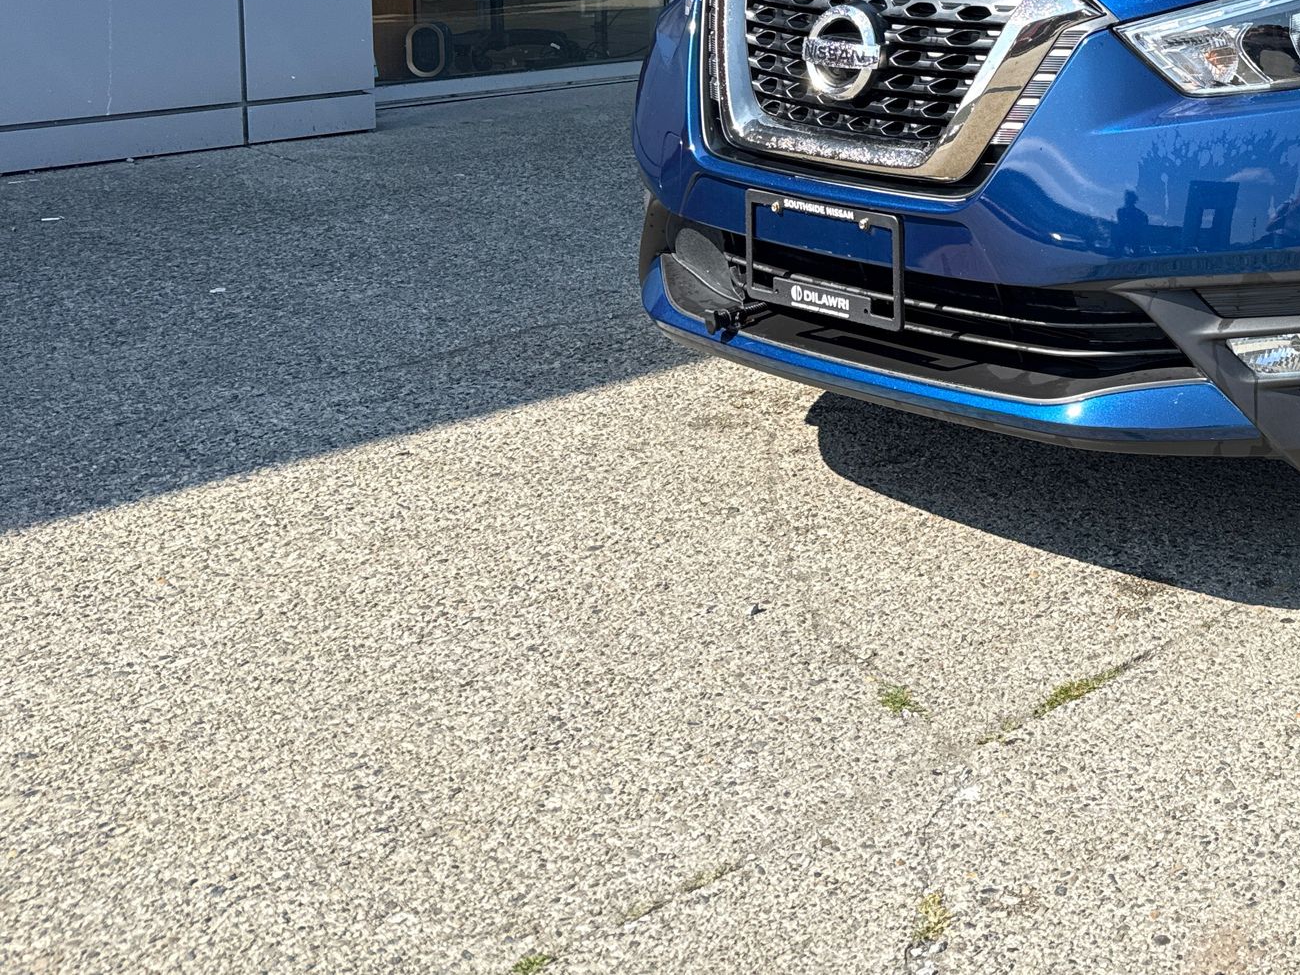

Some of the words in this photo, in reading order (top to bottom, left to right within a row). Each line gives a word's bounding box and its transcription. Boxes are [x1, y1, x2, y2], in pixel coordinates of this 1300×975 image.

[804, 39, 867, 65] NISSAN
[783, 198, 826, 215] SOUTHSIDE
[826, 206, 854, 220] NISSAN
[803, 289, 850, 311] DILAWRI
